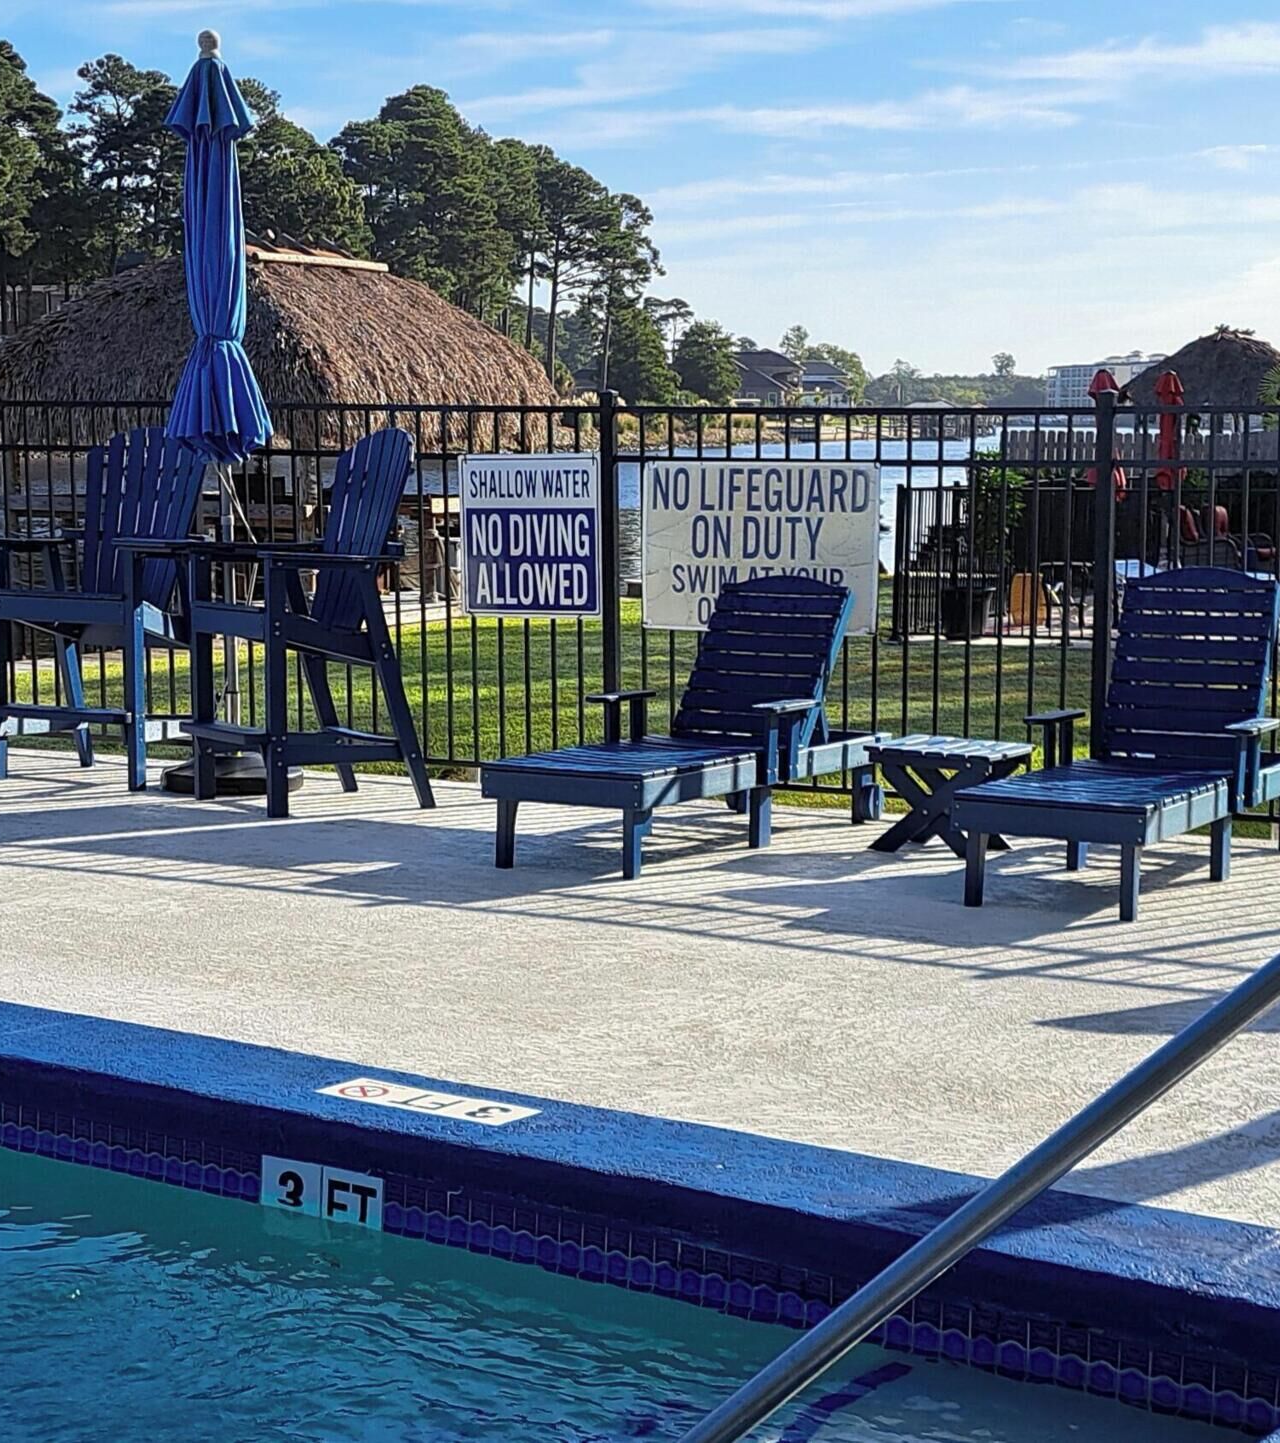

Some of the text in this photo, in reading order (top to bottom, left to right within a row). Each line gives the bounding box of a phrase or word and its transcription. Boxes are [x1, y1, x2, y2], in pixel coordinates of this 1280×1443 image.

[470, 469, 591, 498] SHALLOW WATER
[652, 468, 870, 513] NO LIFEGUARD
[471, 513, 591, 557] NO DIVING
[691, 516, 824, 560] ON DUTY
[476, 562, 588, 606] ALLOWED
[672, 565, 738, 594] SWIM
[277, 1171, 378, 1224] 3 FT
